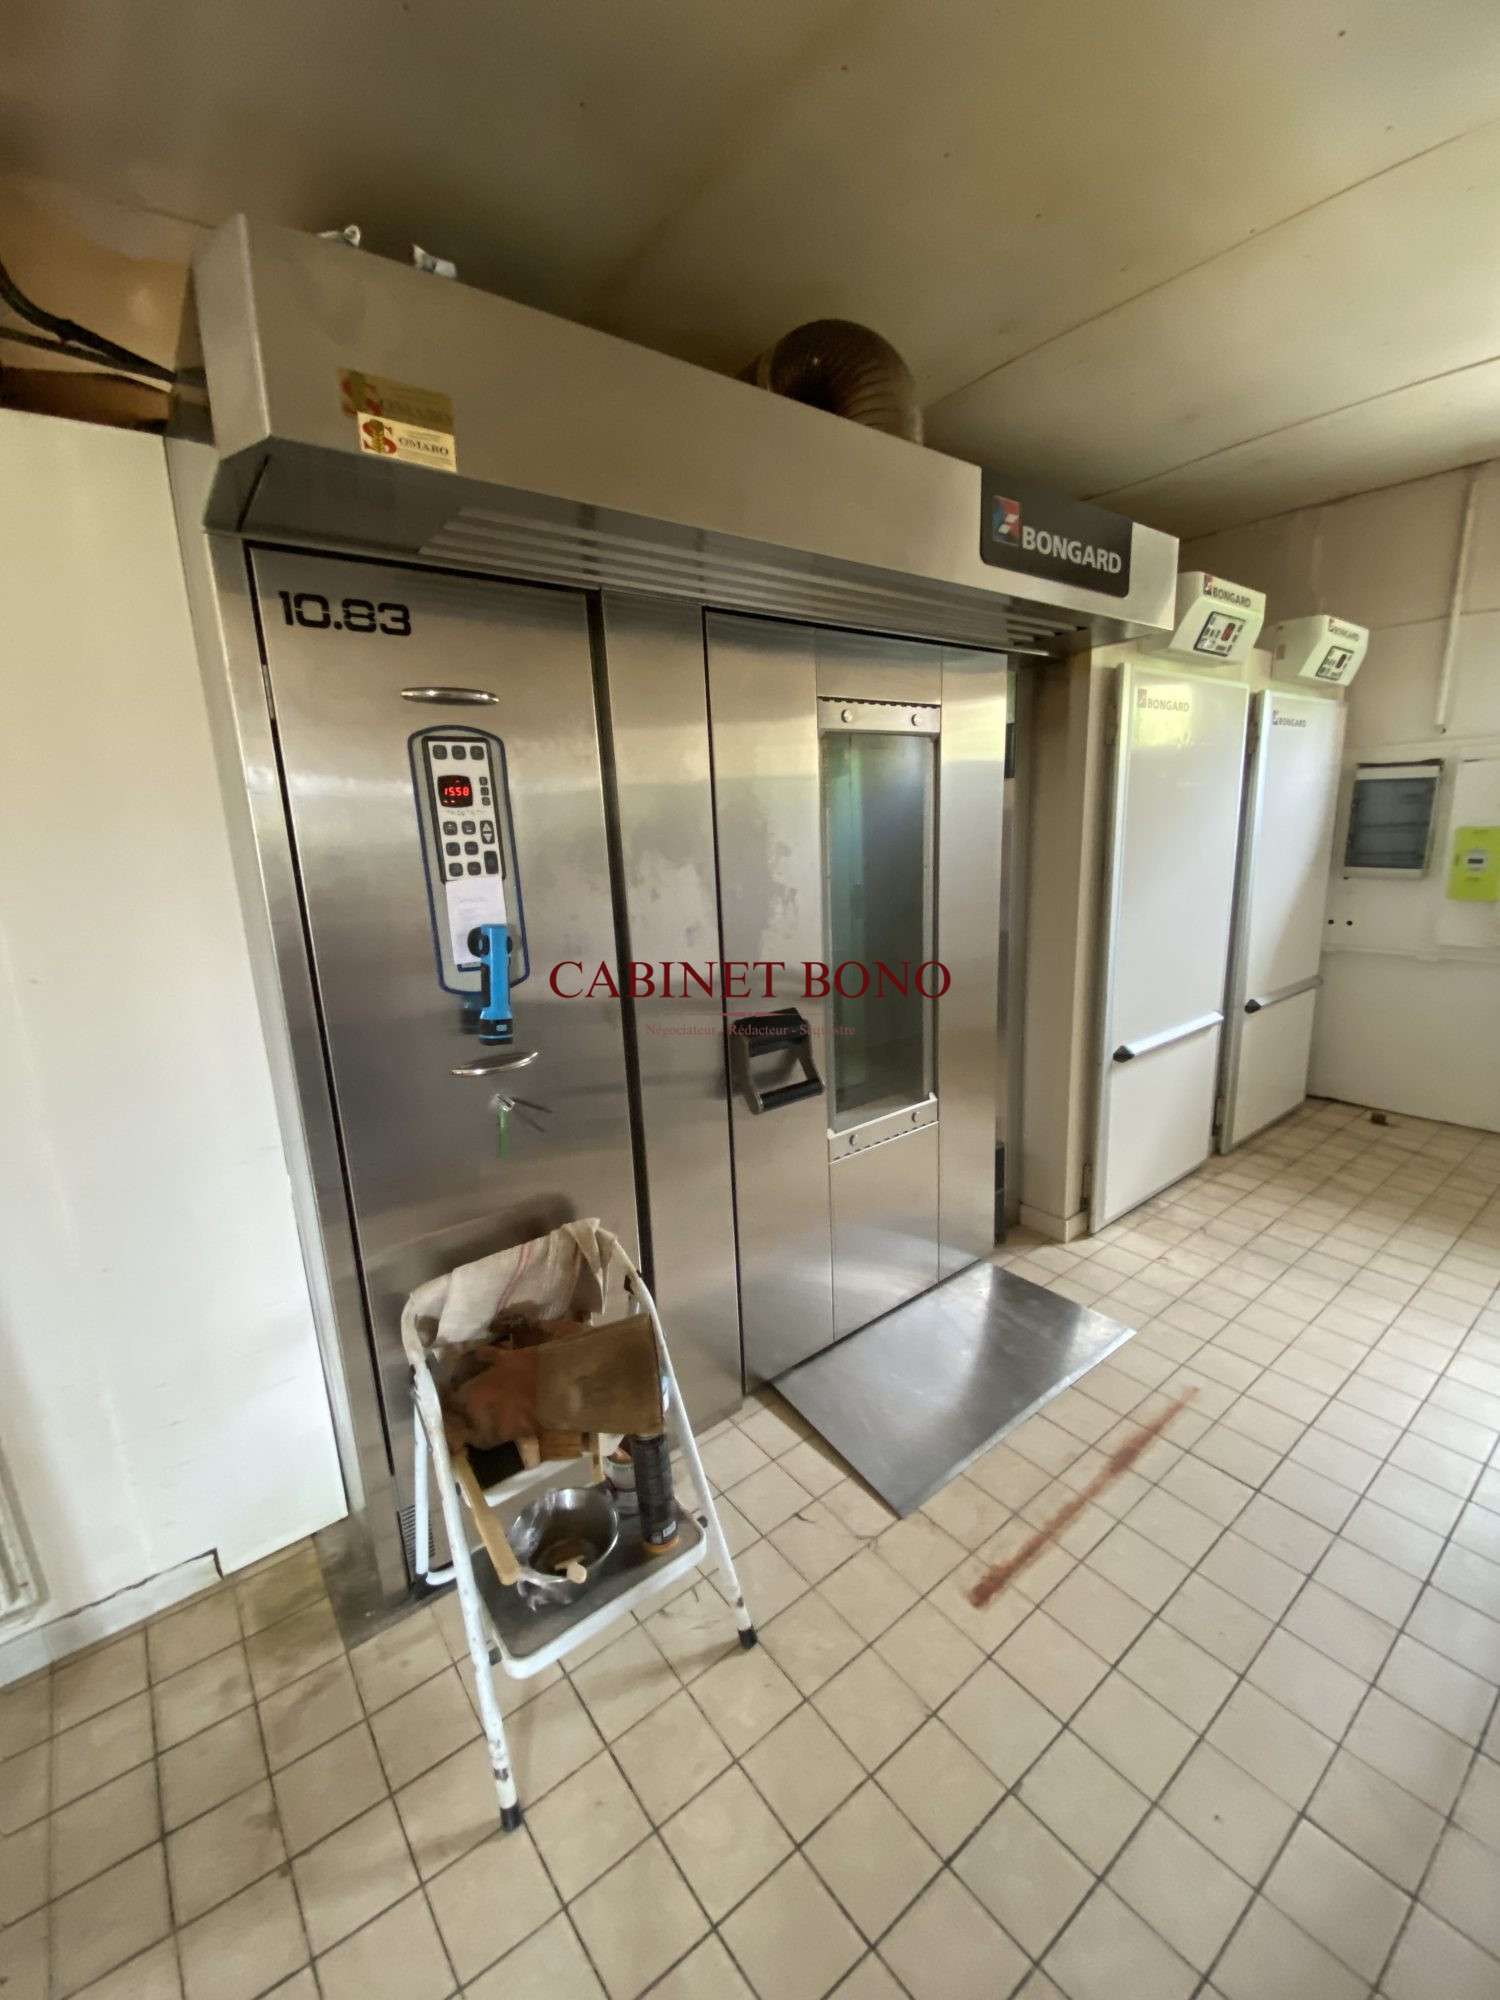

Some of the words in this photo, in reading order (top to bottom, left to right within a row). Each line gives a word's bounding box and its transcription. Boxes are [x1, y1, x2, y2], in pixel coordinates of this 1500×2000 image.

[1021, 525, 1123, 575] BONGARD
[278, 590, 412, 637] 10.83
[1212, 587, 1252, 608] BONGARD
[1147, 697, 1190, 713] BONGARD
